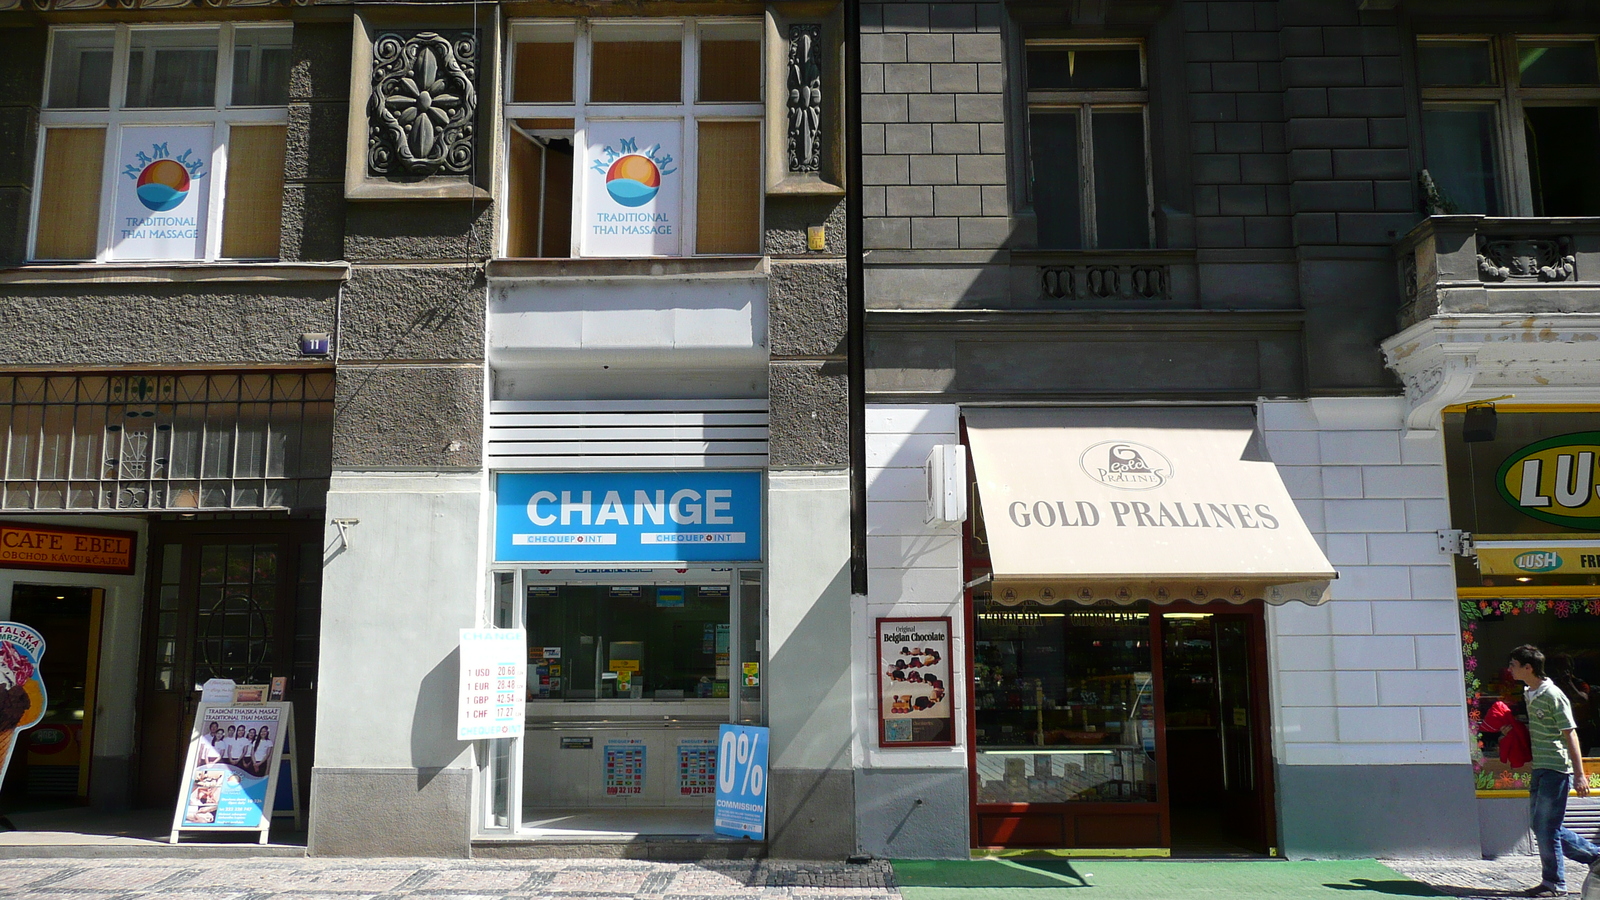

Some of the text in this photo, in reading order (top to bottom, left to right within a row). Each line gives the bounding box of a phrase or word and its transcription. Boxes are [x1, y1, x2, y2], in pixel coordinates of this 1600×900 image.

[126, 216, 196, 227] TRADITIONAL
[597, 212, 669, 222] TRADITIONAL
[121, 229, 199, 239] THAI MASSAGE
[593, 225, 672, 235] THAI MASSAGE
[310, 339, 319, 350] 11
[526, 488, 734, 527] CHANGE
[1008, 500, 1280, 530] GOLD PRALINES
[3, 531, 128, 555] CAFE EBEL
[2, 551, 48, 561] OBCHOD
[1518, 552, 1557, 569] LUSH
[463, 632, 523, 640] CHANGE
[884, 632, 945, 643] Belgian Chocolate
[475, 668, 490, 677] USD
[474, 682, 490, 691] EUR
[473, 695, 489, 705] GBP
[473, 710, 488, 719] CHF
[719, 731, 763, 796] 0%
[717, 799, 763, 813] COMMISSION
